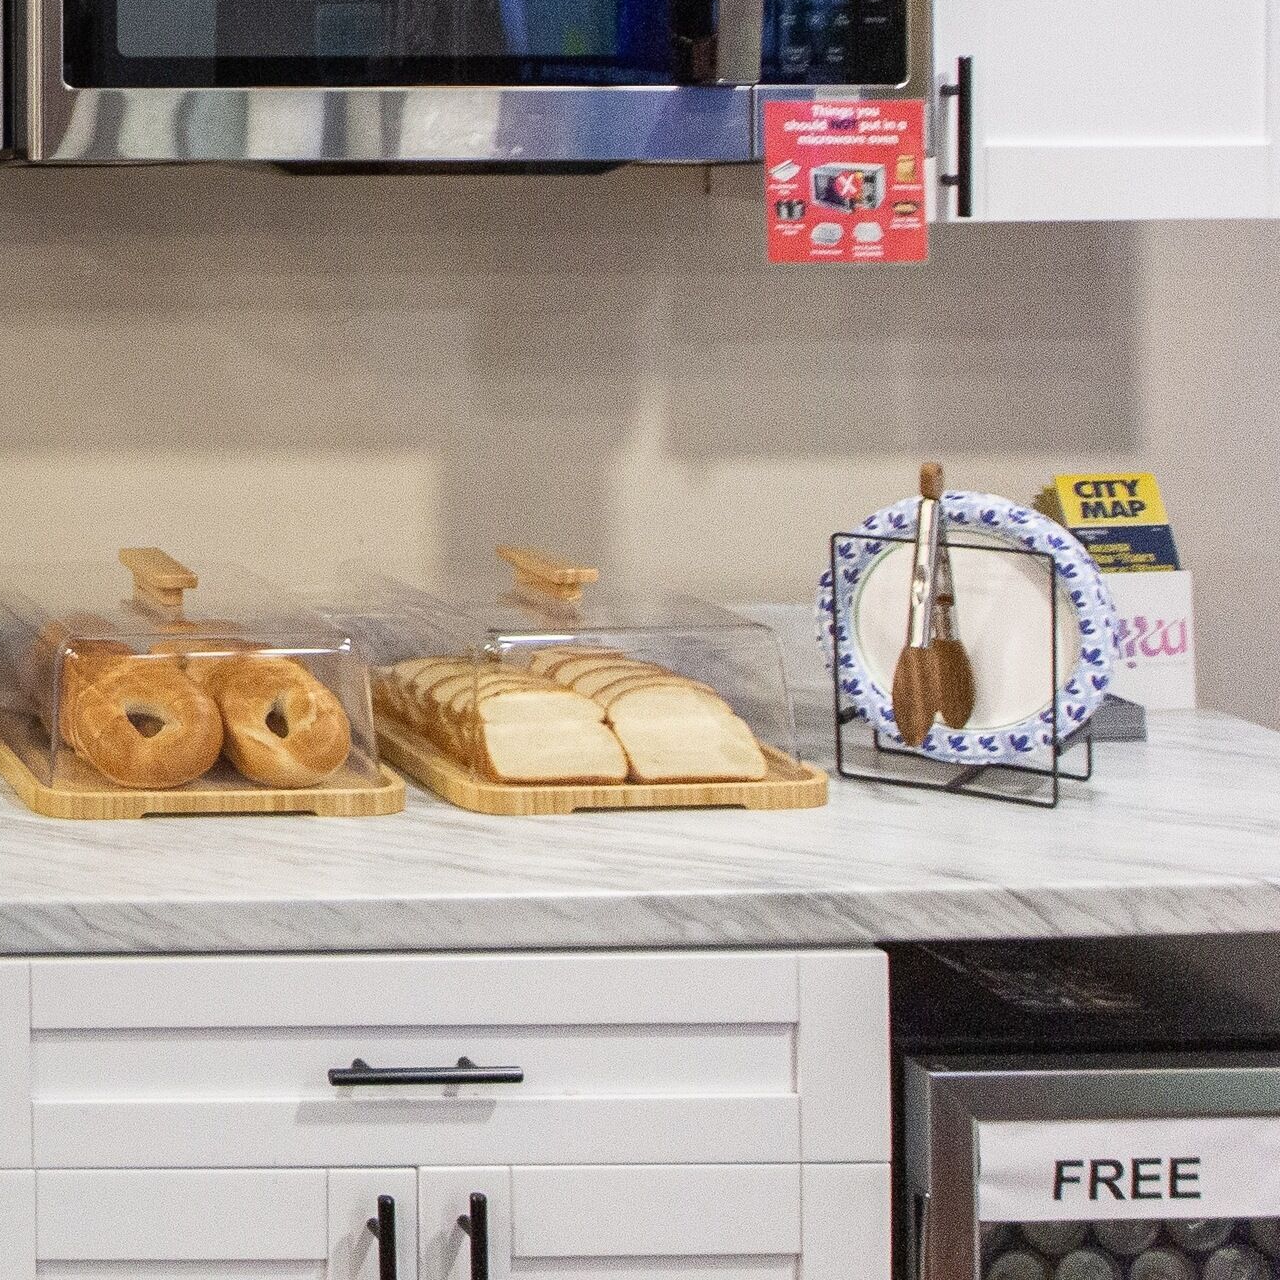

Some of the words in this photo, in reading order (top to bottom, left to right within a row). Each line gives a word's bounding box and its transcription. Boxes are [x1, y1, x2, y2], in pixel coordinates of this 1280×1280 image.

[1073, 479, 1140, 498] CITY
[1081, 499, 1146, 519] MAP
[1052, 1157, 1202, 1201] FREE
